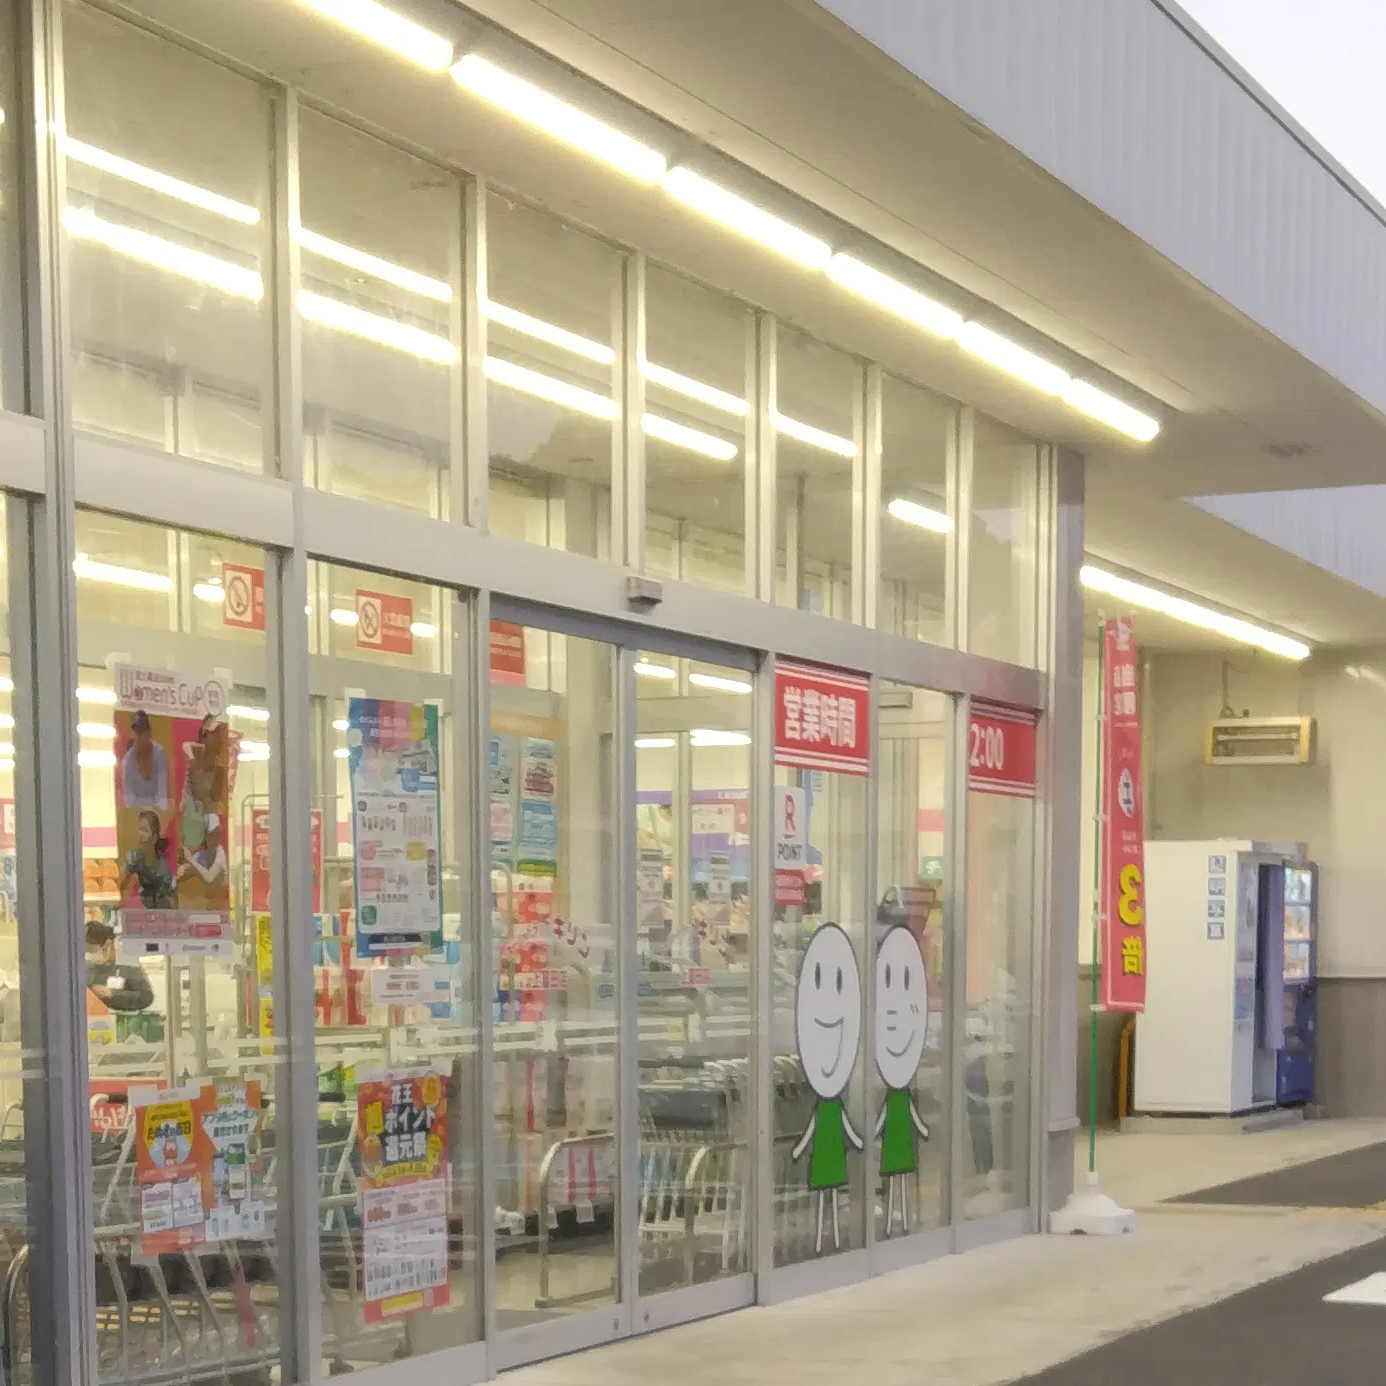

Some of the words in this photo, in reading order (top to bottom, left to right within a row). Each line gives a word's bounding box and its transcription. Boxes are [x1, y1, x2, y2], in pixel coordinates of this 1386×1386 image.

[783, 685, 857, 749] 営業時間
[384, 1103, 436, 1134] ポイント
